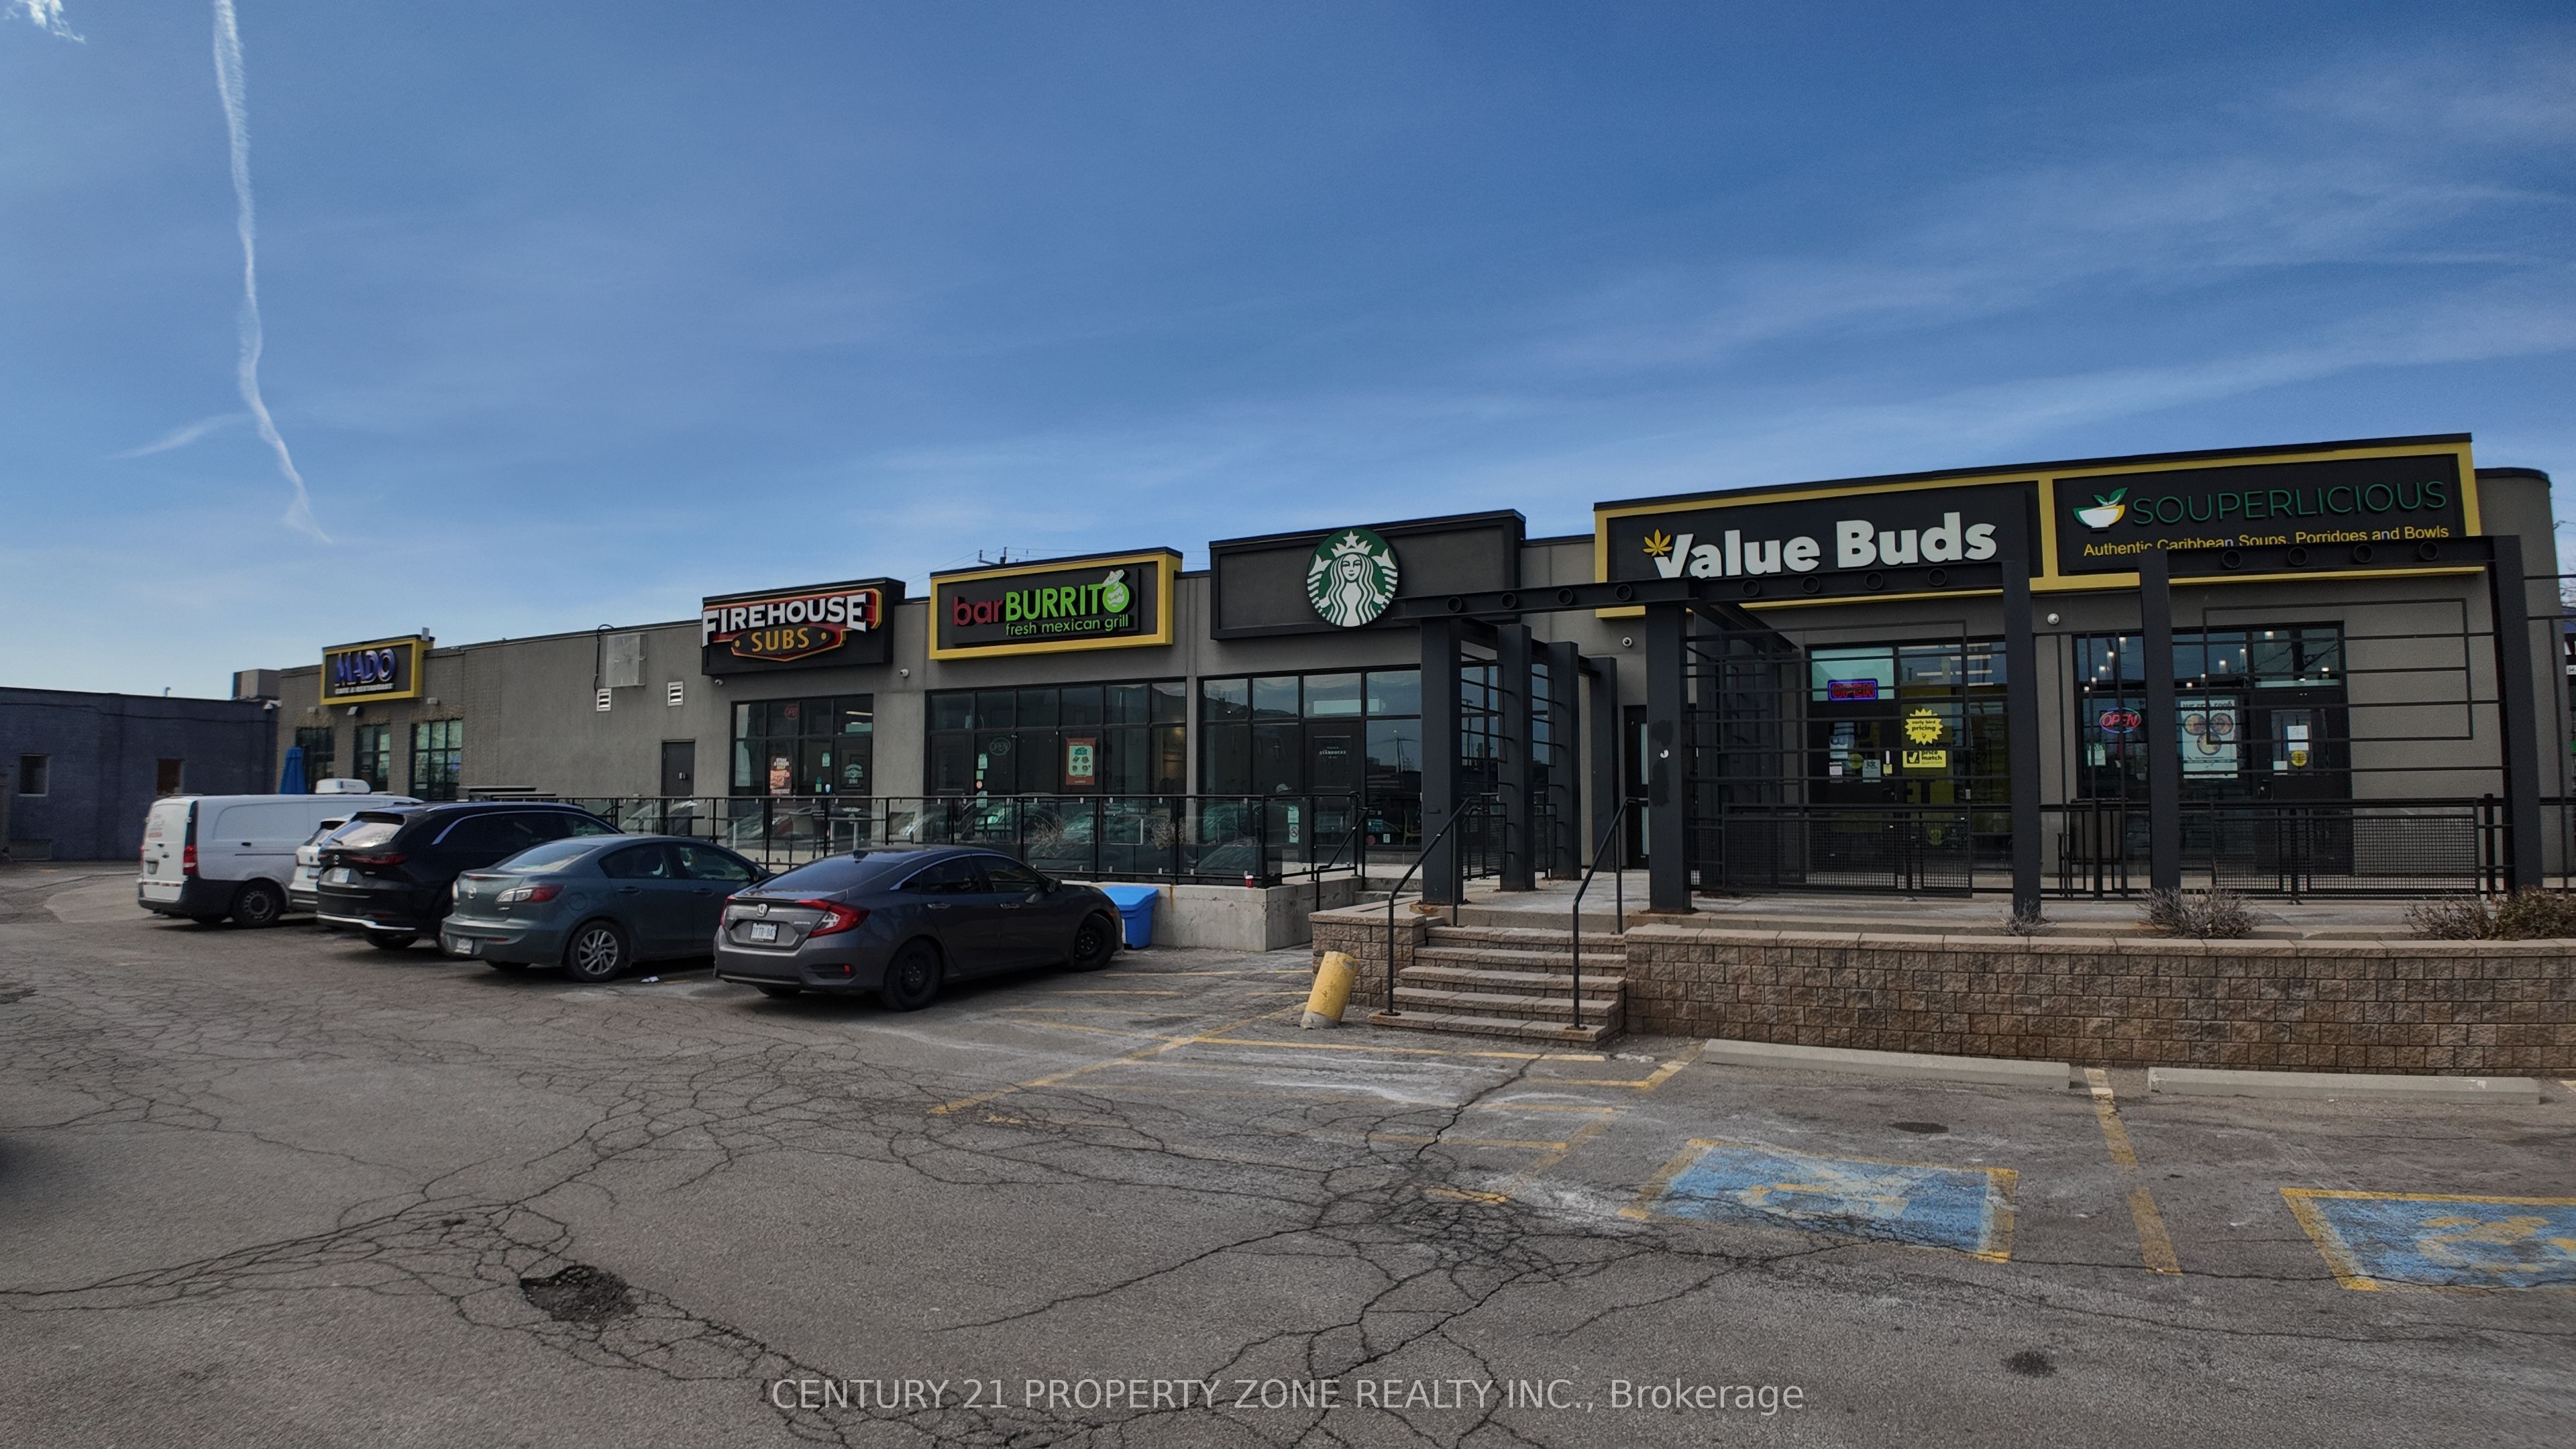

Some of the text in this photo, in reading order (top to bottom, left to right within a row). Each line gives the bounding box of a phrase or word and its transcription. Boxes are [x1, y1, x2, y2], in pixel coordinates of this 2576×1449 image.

[2133, 480, 2447, 525] SOUPERLICIOUS
[1654, 512, 1997, 578] Value Buds
[2084, 541, 2153, 556] Authentic
[2157, 539, 2234, 549] Caribbean
[2296, 530, 2368, 544] Porridges
[2372, 527, 2400, 540] and
[2404, 525, 2449, 539] Bowls
[702, 592, 866, 648] FIREHOUSE
[1006, 614, 1128, 636] fresh mexican grill
[751, 627, 809, 652] SUBS
[334, 648, 395, 686] MADO
[1832, 684, 1874, 698] OPEN
[1912, 724, 1936, 733] pricing
